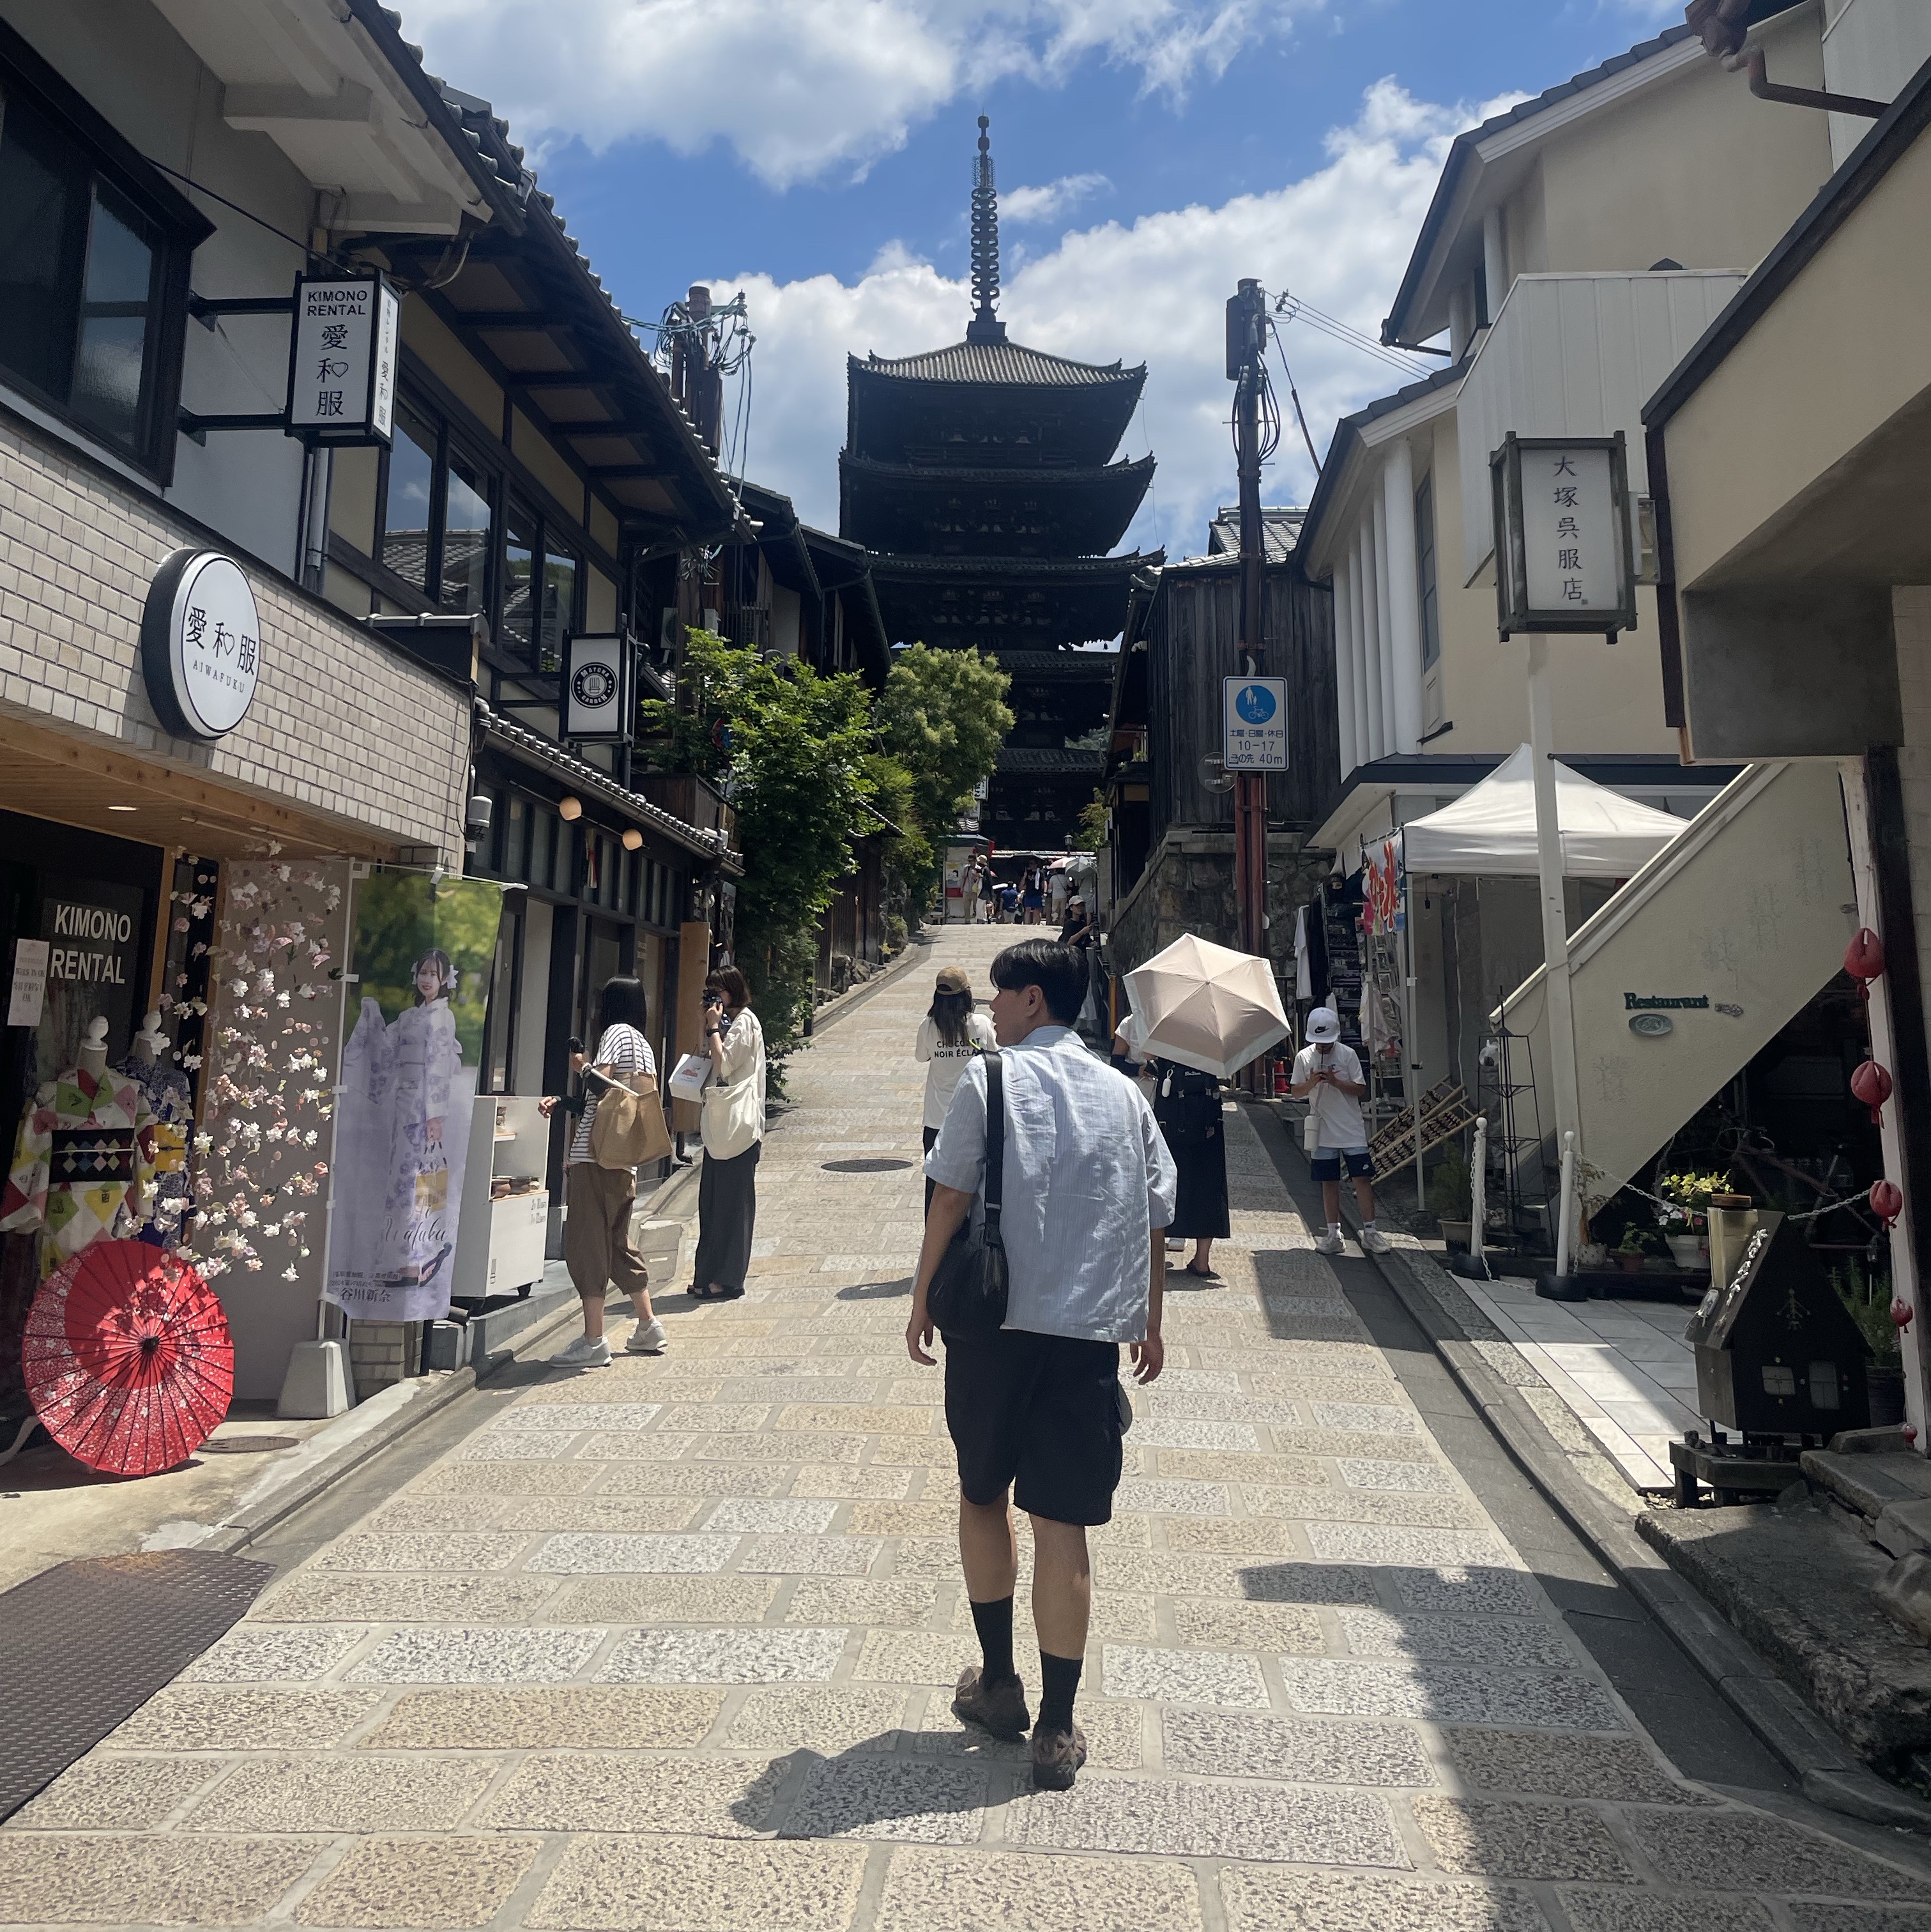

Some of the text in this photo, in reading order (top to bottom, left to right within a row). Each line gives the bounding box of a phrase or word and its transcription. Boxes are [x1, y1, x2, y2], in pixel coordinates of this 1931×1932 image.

[307, 289, 367, 302] KIMONO
[307, 305, 366, 316] RENTAL
[1553, 456, 1583, 601] 大塚呉服店
[193, 659, 245, 693] AIWAFUKU
[580, 667, 609, 678] MATCHA
[1239, 740, 1275, 752] 10-17
[1259, 753, 1283, 765] 40m
[54, 904, 132, 942] KIMONO
[50, 949, 126, 984] RENTAL
[1623, 993, 1709, 1009] Restaurant
[956, 1048, 979, 1057] ÉCLA
